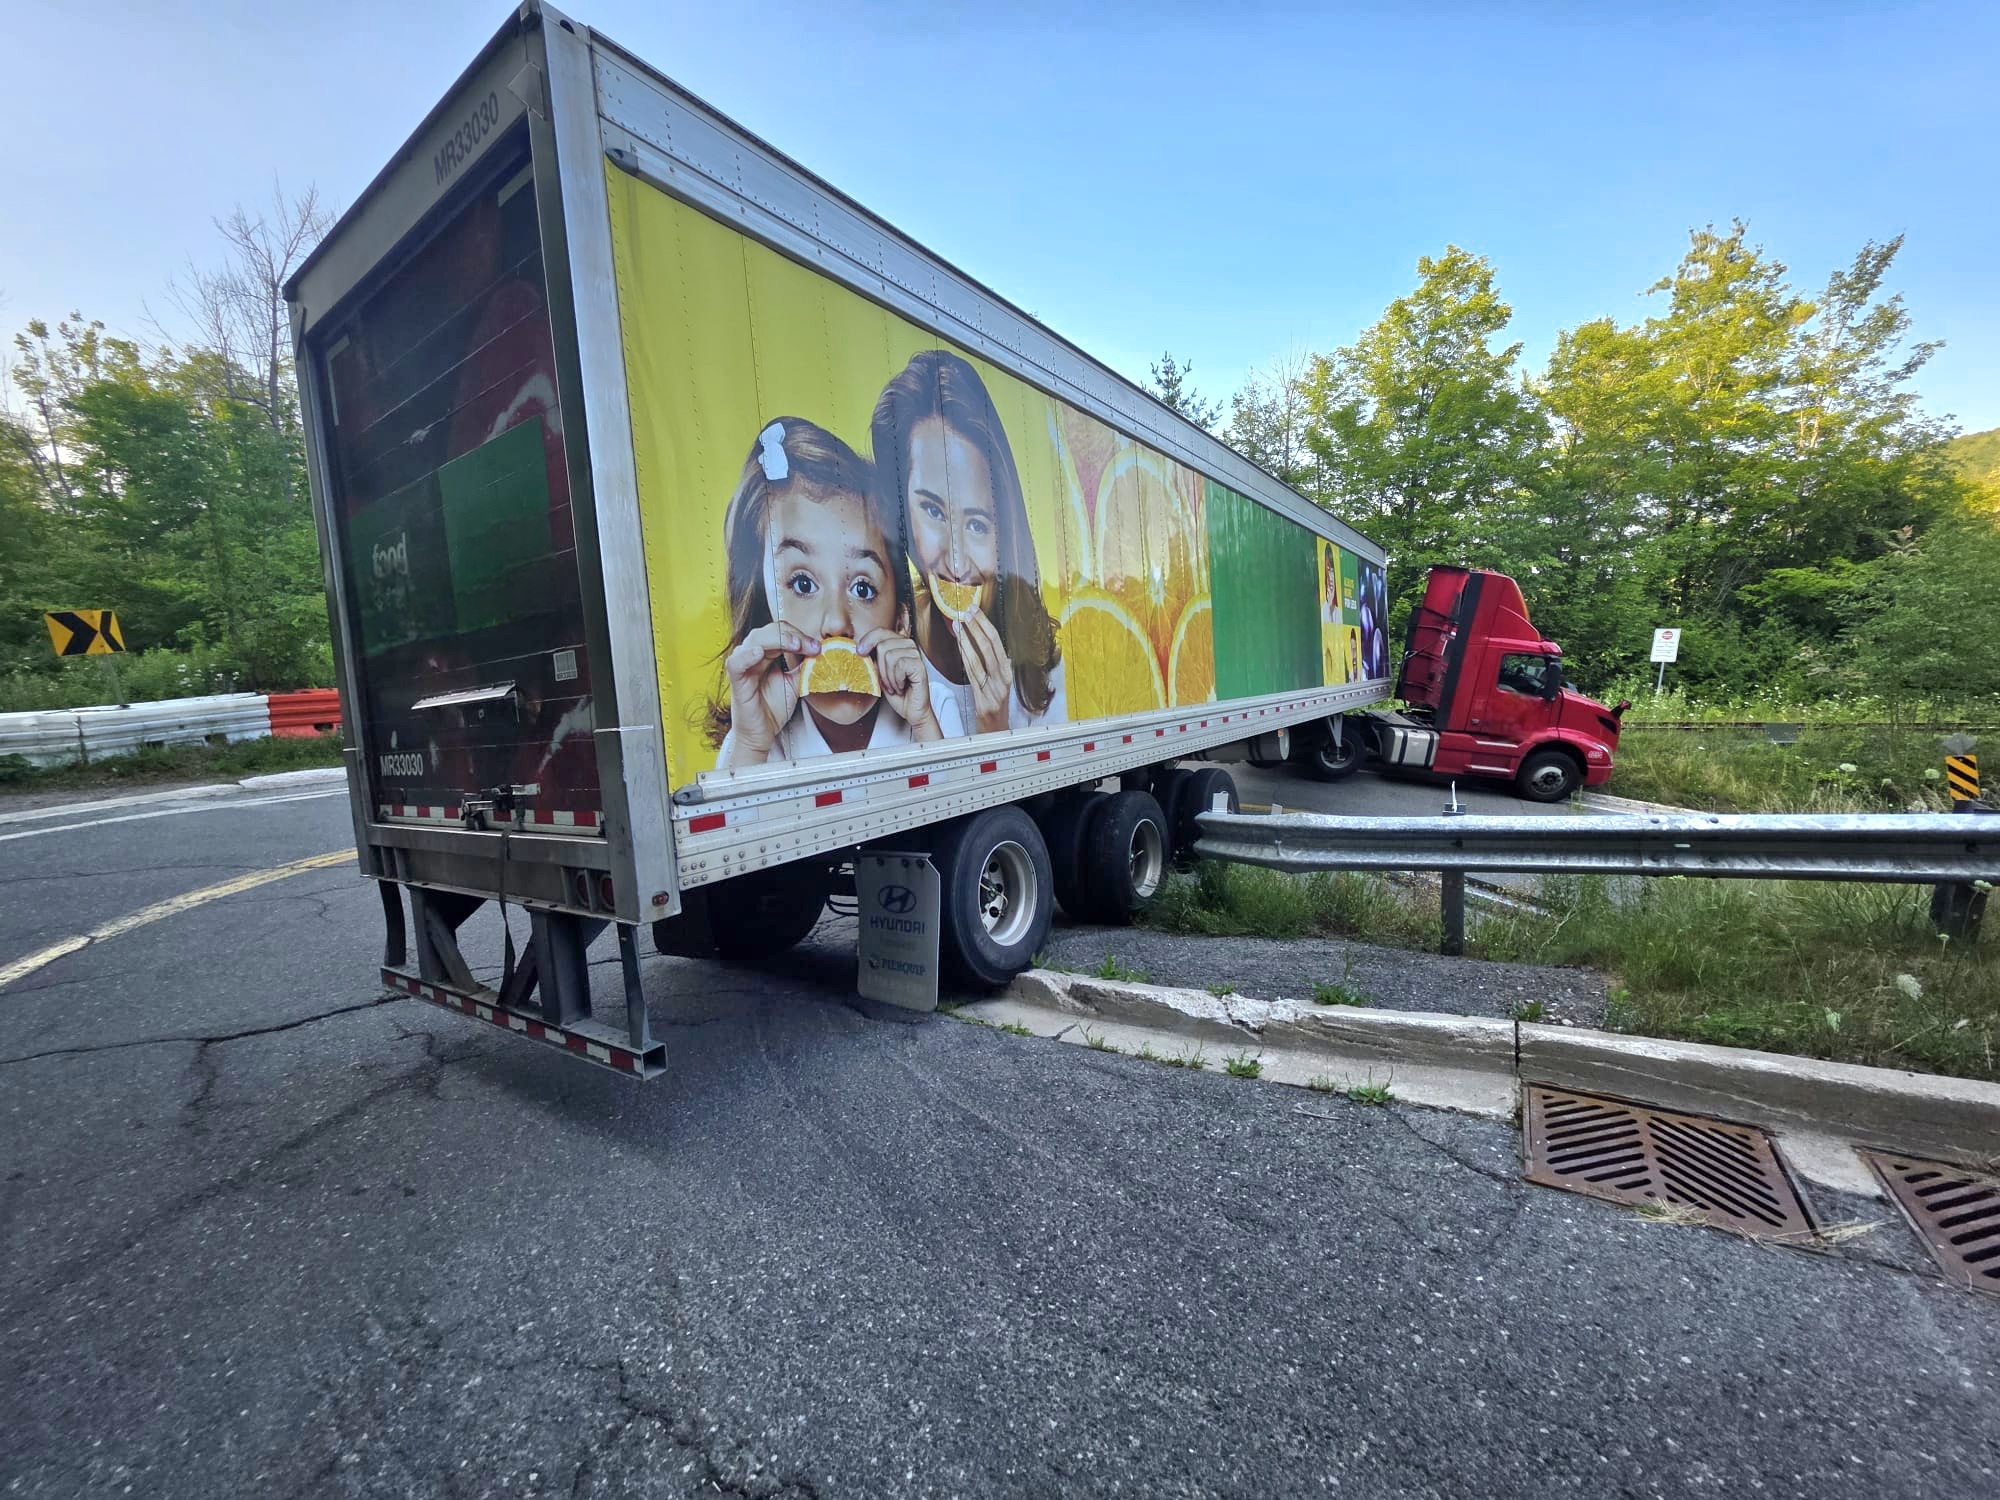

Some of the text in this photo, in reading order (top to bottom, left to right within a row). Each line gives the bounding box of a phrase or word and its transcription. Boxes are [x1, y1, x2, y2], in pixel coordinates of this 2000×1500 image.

[433, 91, 499, 186] MR33030
[380, 753, 424, 776] MR33030
[870, 915, 925, 935] HYUNDAI
